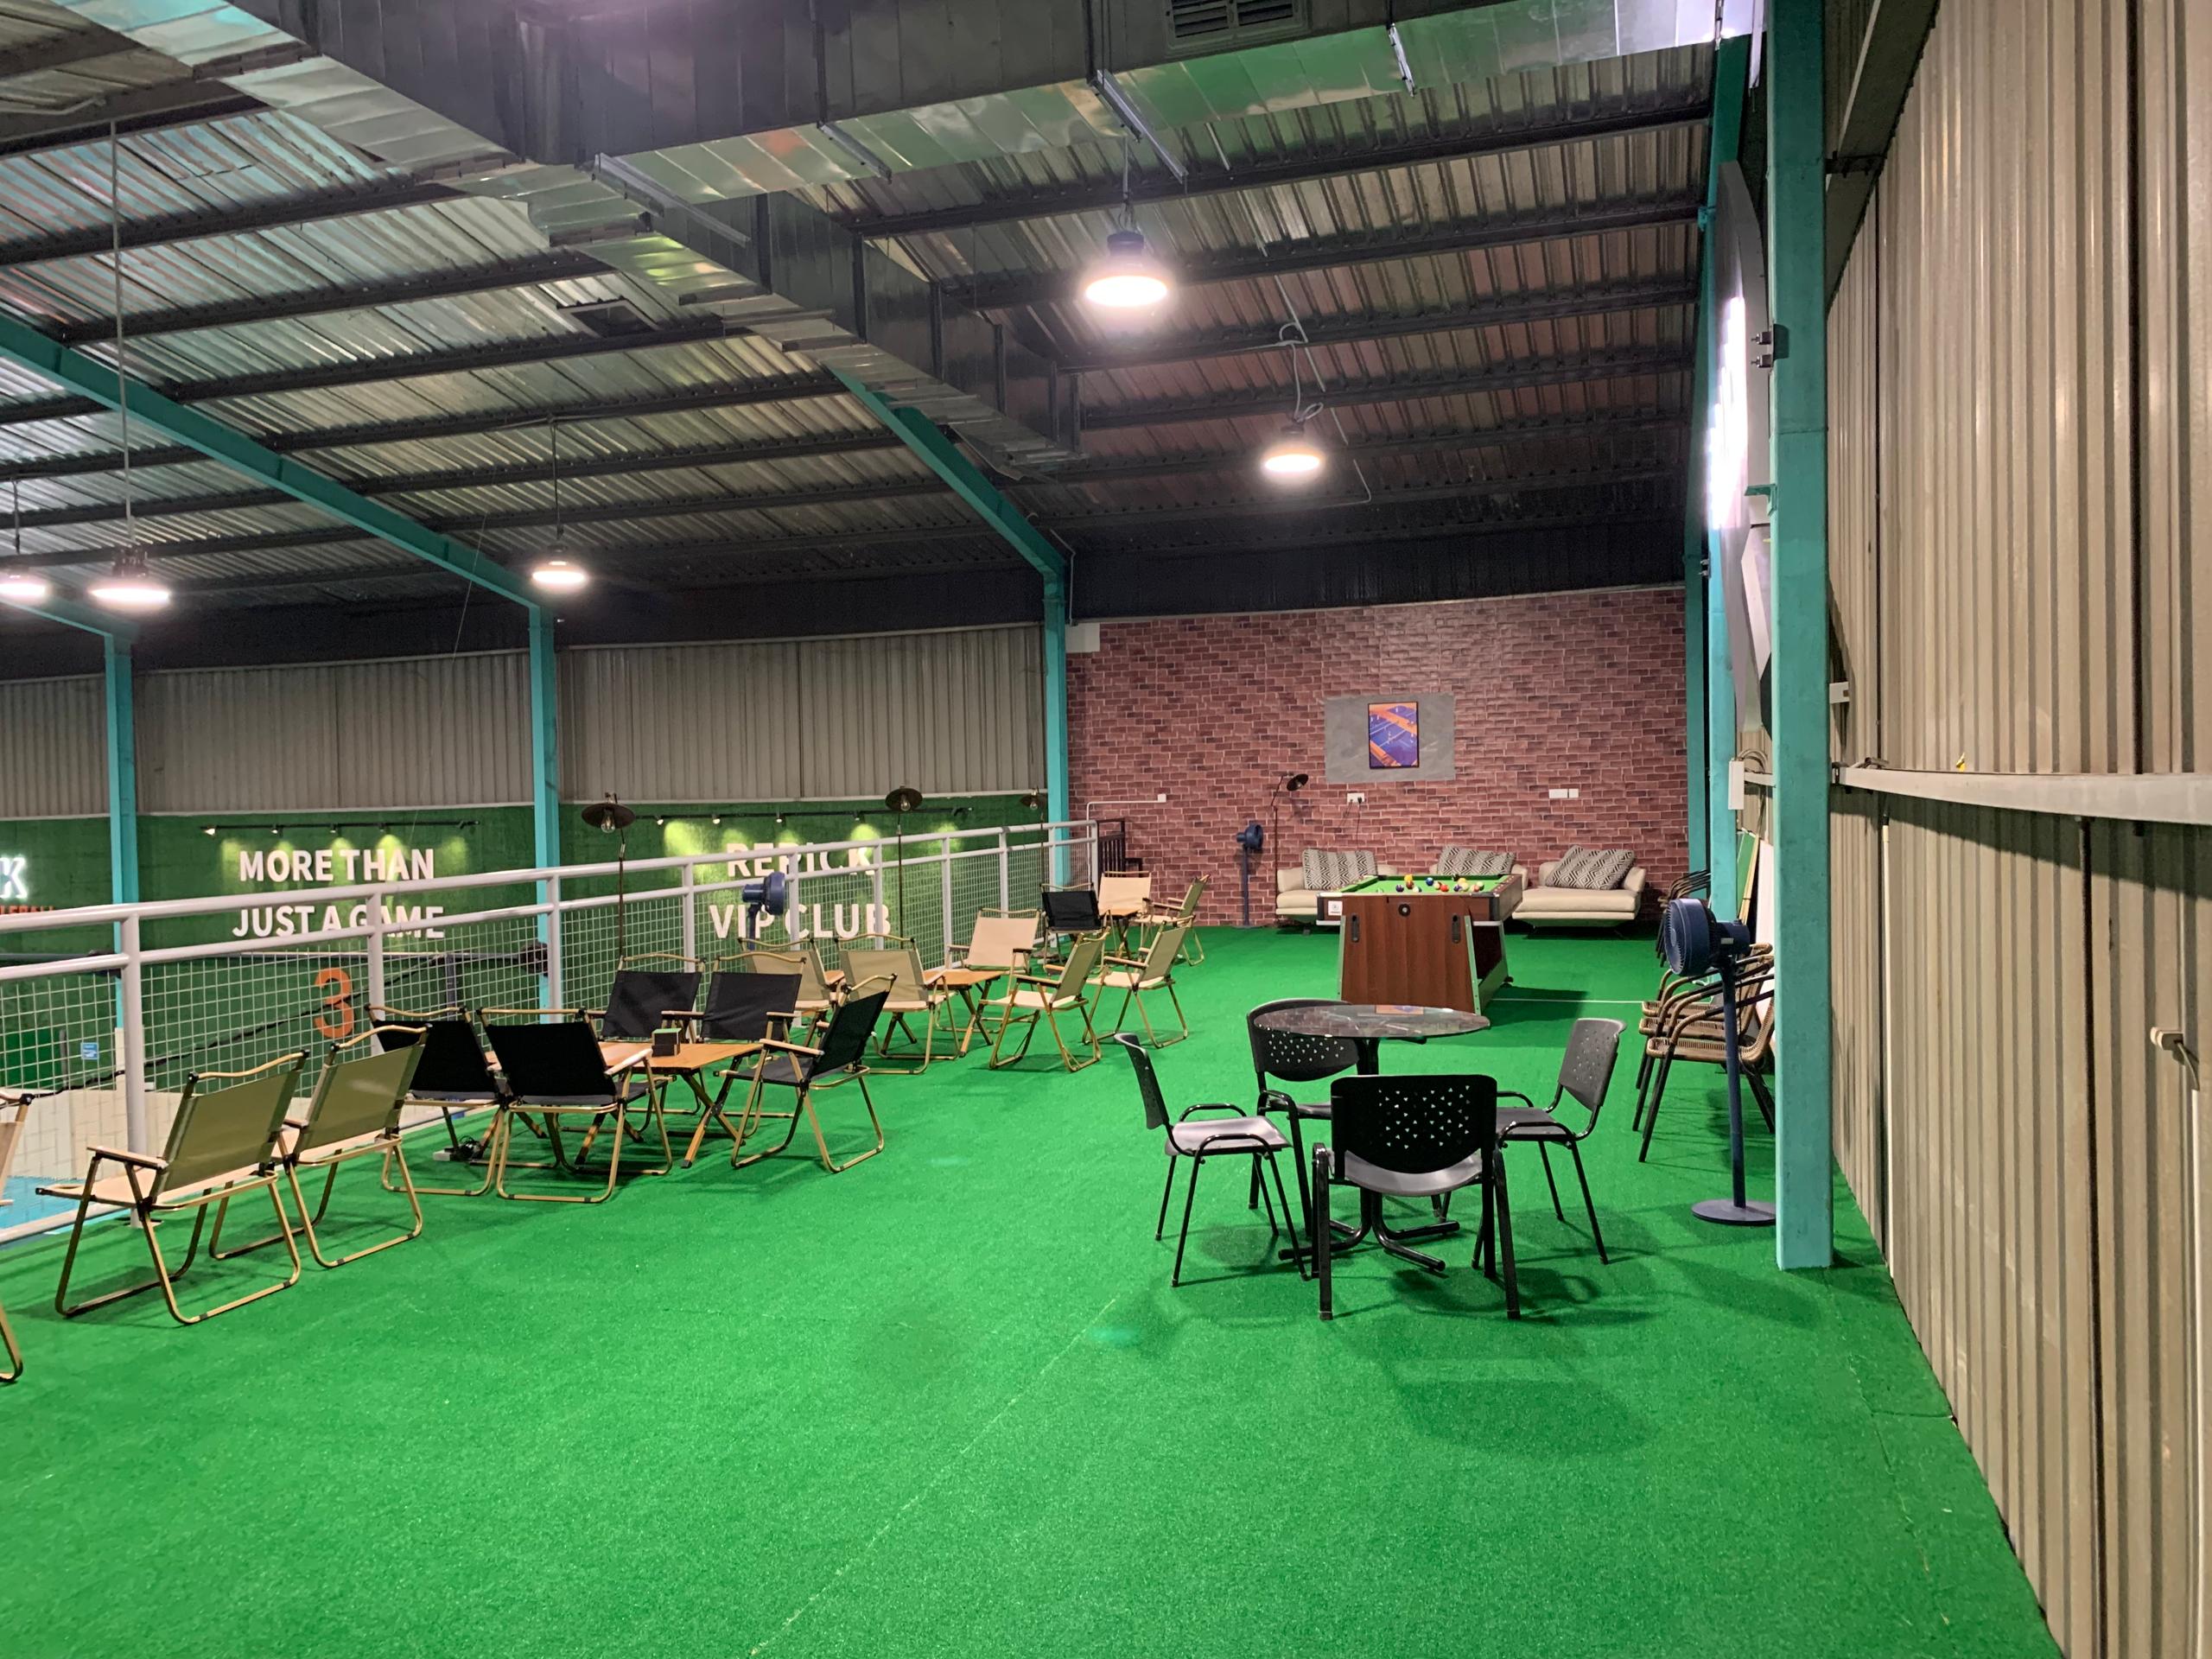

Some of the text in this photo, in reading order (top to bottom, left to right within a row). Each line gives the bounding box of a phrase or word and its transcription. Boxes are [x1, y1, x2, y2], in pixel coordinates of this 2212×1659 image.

[239, 848, 434, 882] MORE THAN
[232, 904, 444, 938] JUST A GAME
[709, 904, 892, 940] VIP CLUB
[314, 967, 354, 1038] 3
